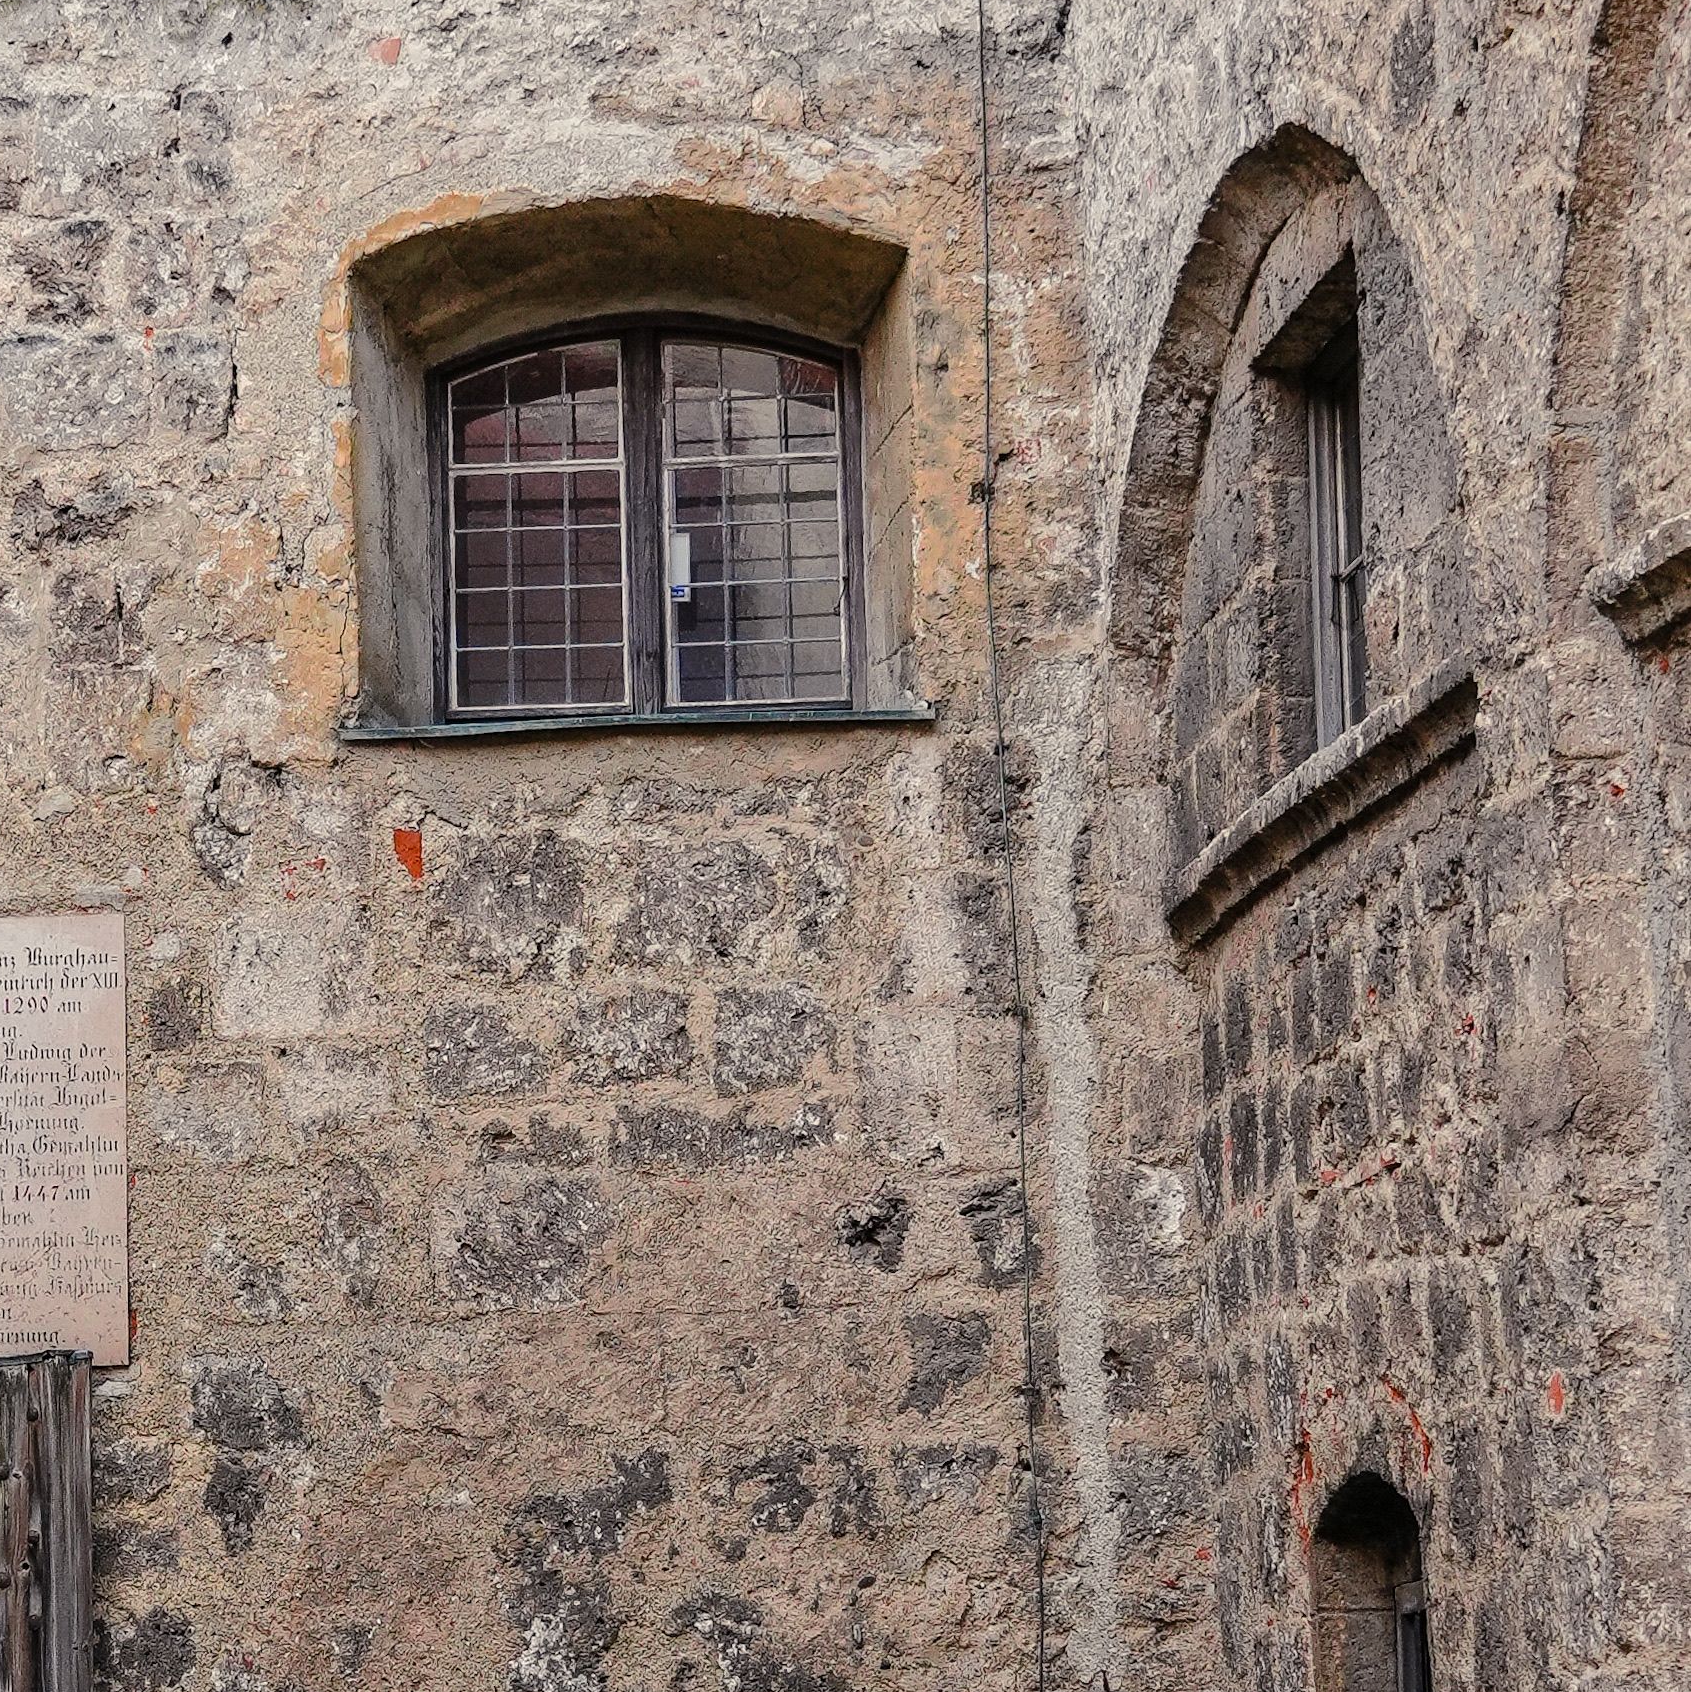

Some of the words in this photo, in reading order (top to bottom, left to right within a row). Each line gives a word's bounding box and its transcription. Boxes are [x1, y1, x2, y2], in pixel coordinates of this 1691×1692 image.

[60, 967, 87, 989] der
[3, 995, 49, 1015] 1290
[57, 1001, 82, 1013] am
[3, 1039, 71, 1065] Ludwig
[78, 1042, 107, 1059] der
[94, 1162, 124, 1178] von
[12, 1185, 59, 1202] 1447
[65, 1187, 90, 1200] am
